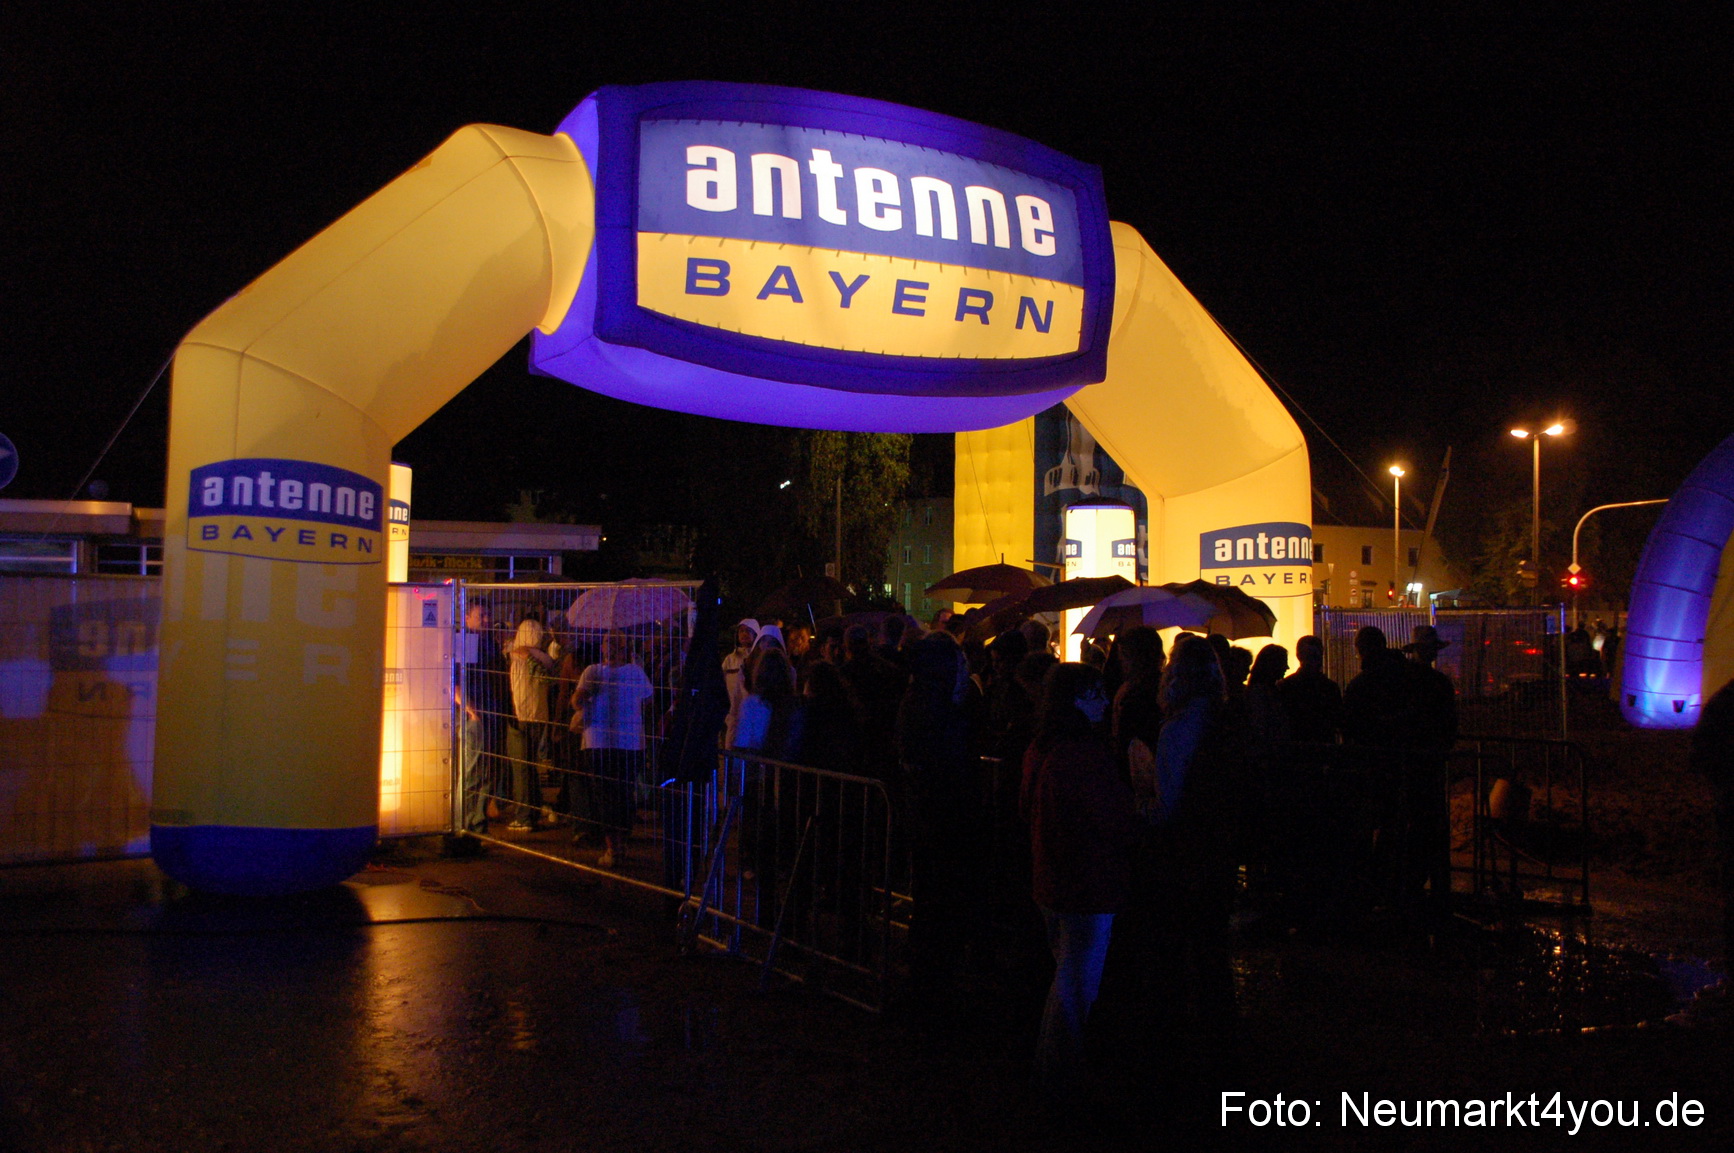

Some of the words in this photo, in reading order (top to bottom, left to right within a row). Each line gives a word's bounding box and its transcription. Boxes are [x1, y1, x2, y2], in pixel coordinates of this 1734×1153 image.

[686, 145, 1056, 257] antenne
[685, 257, 1054, 334] BAYERN
[203, 471, 374, 521] antenne
[202, 524, 373, 554] BAYERN
[1215, 573, 1312, 587] BAYER
